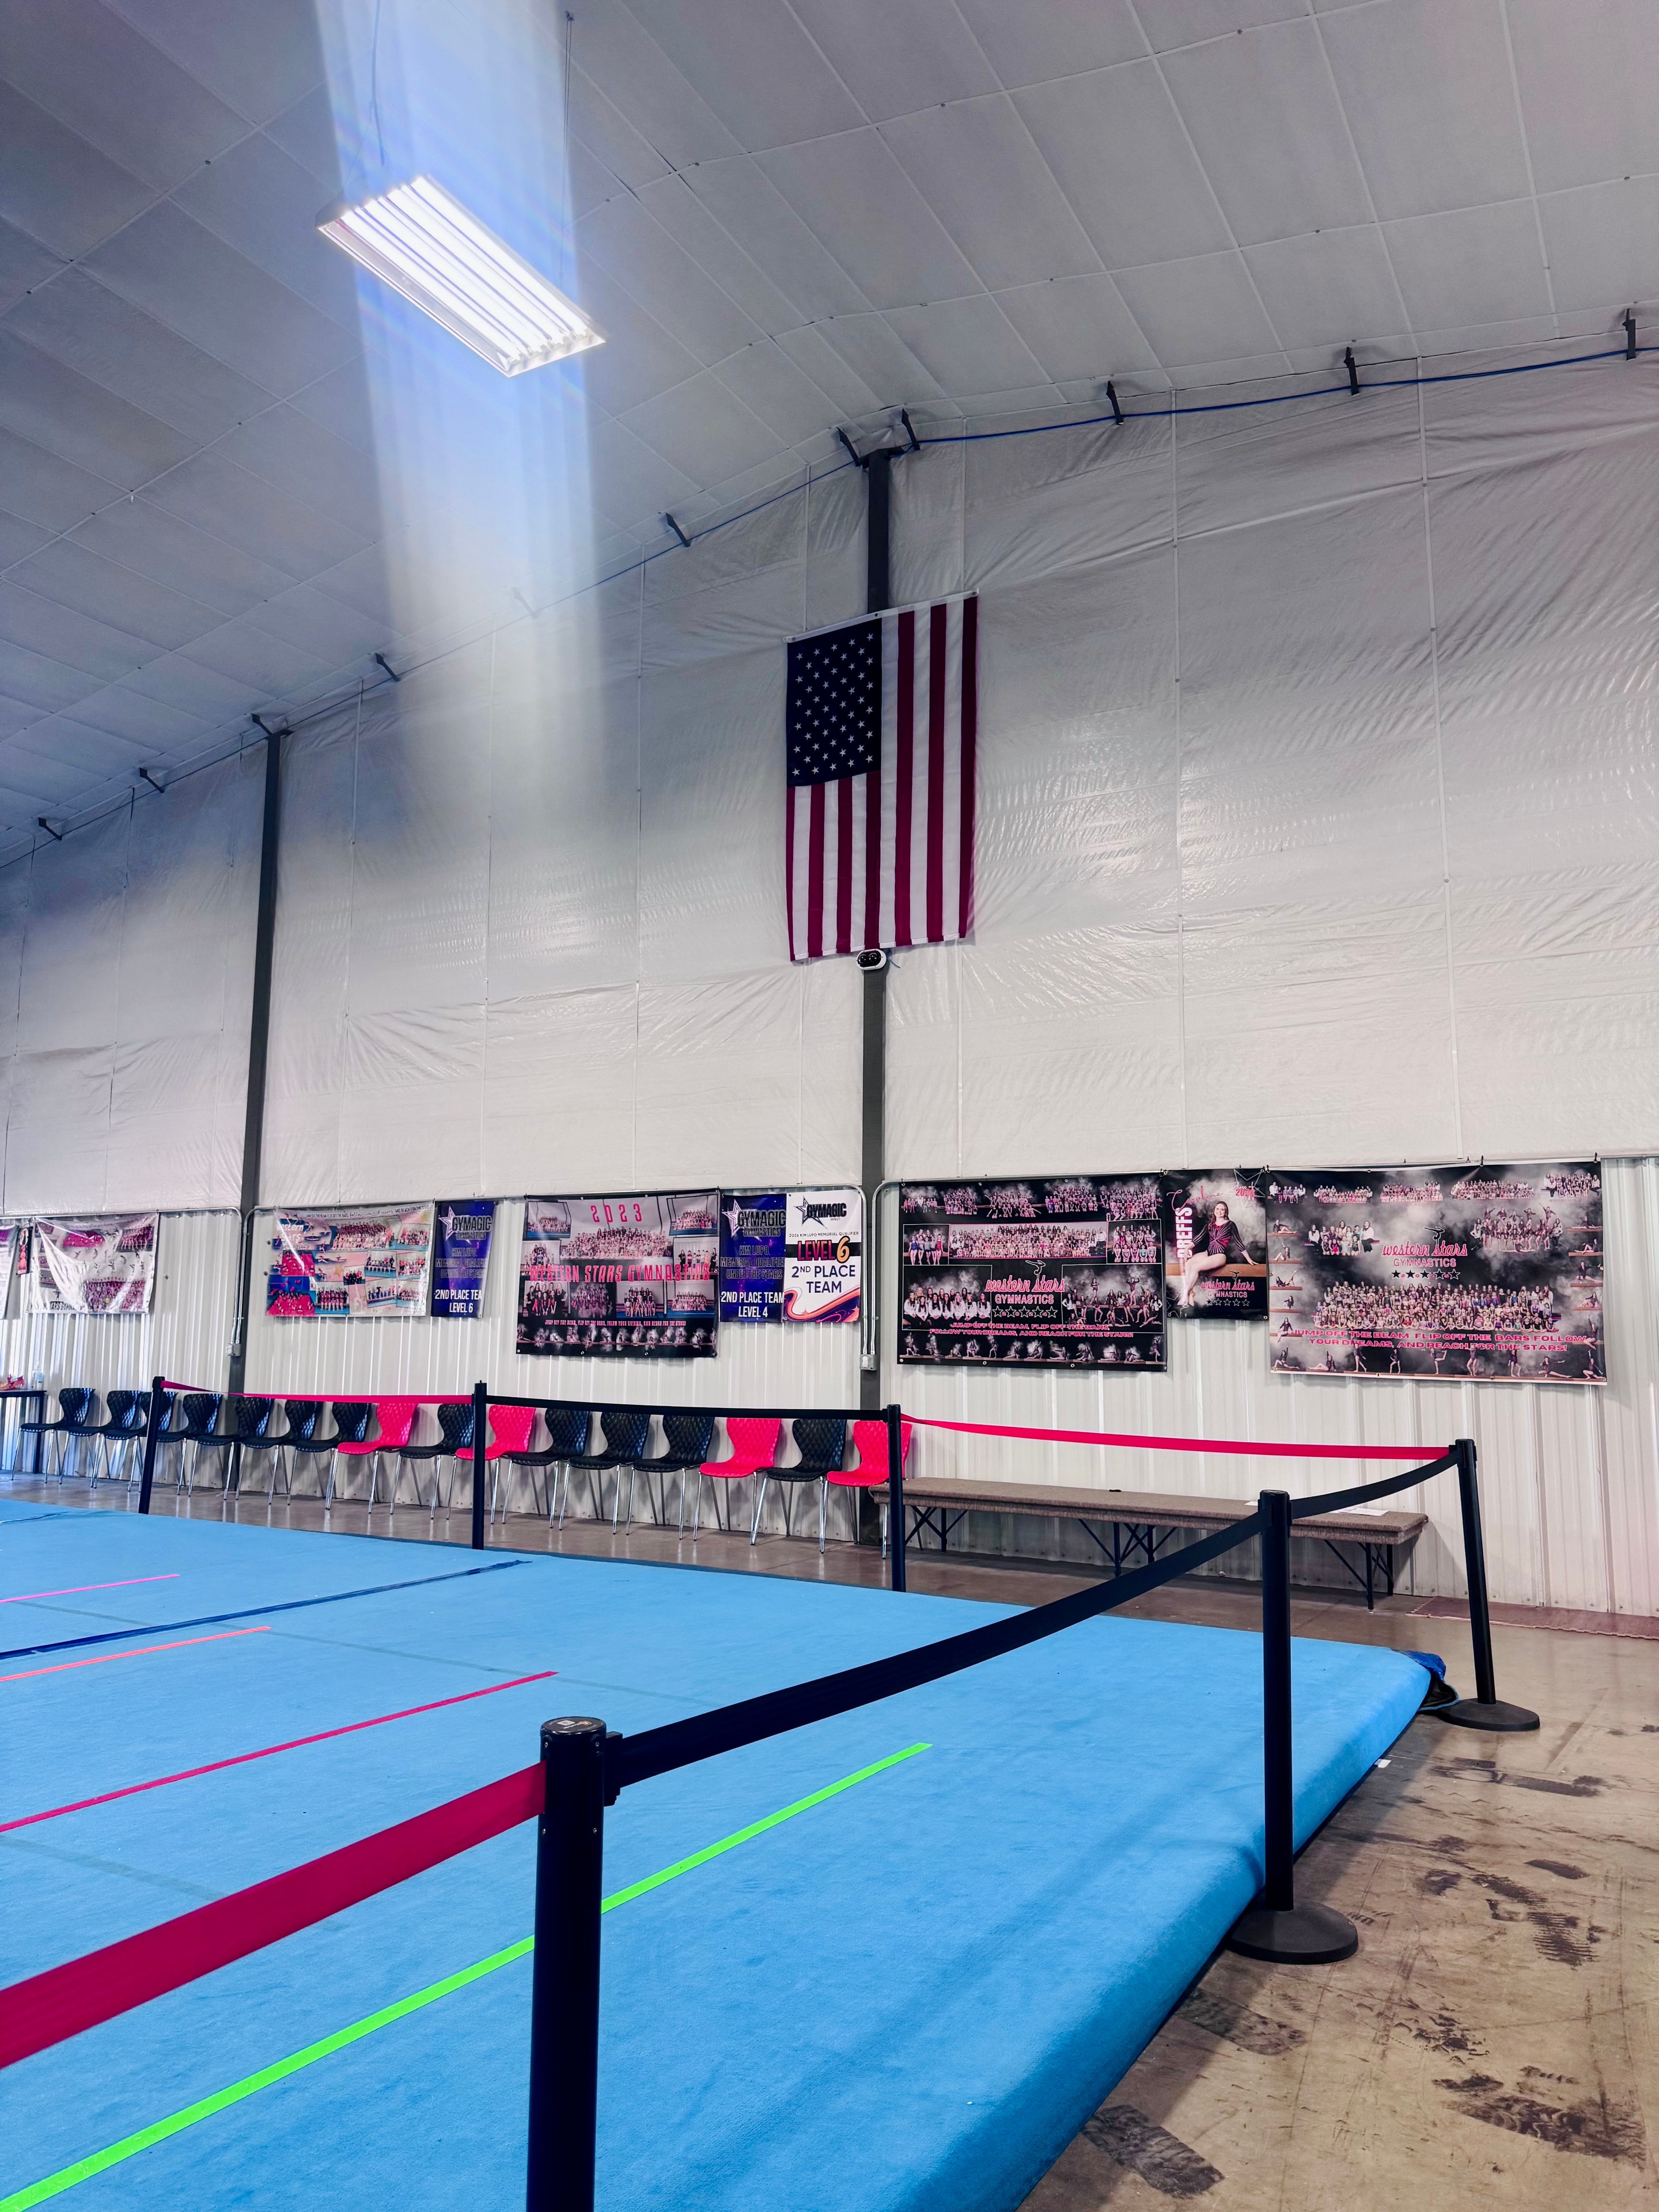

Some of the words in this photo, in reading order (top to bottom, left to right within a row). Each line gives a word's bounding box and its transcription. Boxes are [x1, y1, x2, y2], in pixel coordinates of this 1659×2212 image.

[1166, 1185, 1224, 1211] Caroline
[590, 1203, 642, 1223] 2023
[806, 1203, 847, 1218] GYMAGIC
[452, 1215, 493, 1231] GYMAGIC
[738, 1209, 786, 1228] GYMAGIC
[743, 1228, 781, 1237] GYMNASTICS
[739, 1245, 751, 1255] KIM
[752, 1245, 769, 1255] LUPO
[797, 1239, 836, 1261] LEVEL
[836, 1236, 850, 1263] 6
[1381, 1240, 1430, 1256] western
[1431, 1240, 1468, 1256] stars
[720, 1257, 753, 1267] MEMORIAL
[1393, 1258, 1457, 1267] GYMNASTICS
[529, 1265, 579, 1282] WESTERN
[584, 1265, 623, 1283] STARS
[627, 1263, 710, 1282] GYMNASTICS
[726, 1268, 747, 1279] UNDER
[748, 1268, 761, 1279] THE
[761, 1268, 783, 1279] STARS
[791, 1266, 811, 1278] 2ND
[814, 1264, 856, 1278] PLACE
[806, 1281, 842, 1293] TEAM
[984, 1275, 1031, 1293] western
[1031, 1275, 1065, 1293] stars
[1200, 1278, 1231, 1290] western
[1231, 1279, 1255, 1291] stars
[434, 1289, 449, 1300] 2ND
[450, 1289, 469, 1300] PLACE
[471, 1289, 483, 1300] TEA
[721, 1291, 737, 1302] 2ND
[739, 1291, 762, 1303] PLACE
[995, 1294, 1054, 1304] GYMNASTICS
[449, 1302, 468, 1313] LEVEL
[468, 1302, 474, 1313] 6
[738, 1306, 761, 1317] LEVEL
[762, 1306, 768, 1317] 4
[1415, 1332, 1441, 1340] FLIP
